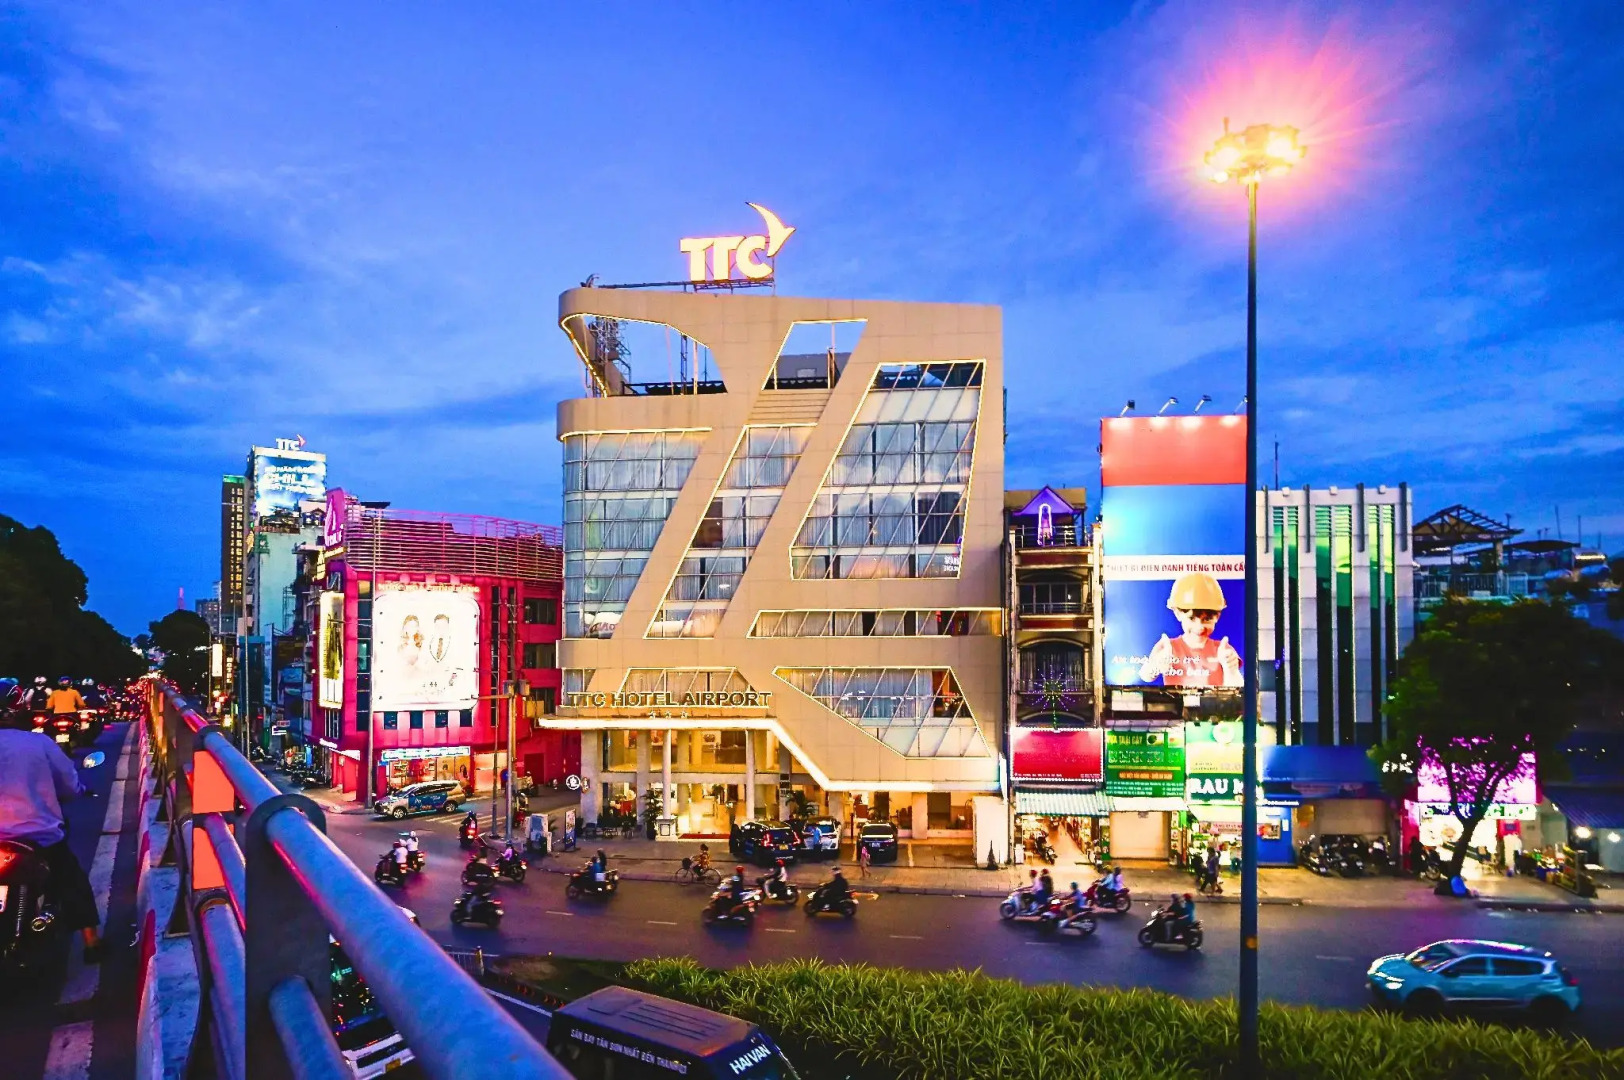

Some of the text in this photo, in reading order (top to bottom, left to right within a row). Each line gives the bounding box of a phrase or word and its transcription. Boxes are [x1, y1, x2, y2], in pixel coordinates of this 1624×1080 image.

[680, 235, 774, 281] TTC
[276, 437, 301, 451] TTC
[1162, 563, 1184, 571] DANH
[1186, 561, 1209, 572] TIẾNG
[1212, 561, 1233, 572] TOÀN
[567, 691, 772, 707] TTC HOTEL AIRPORT
